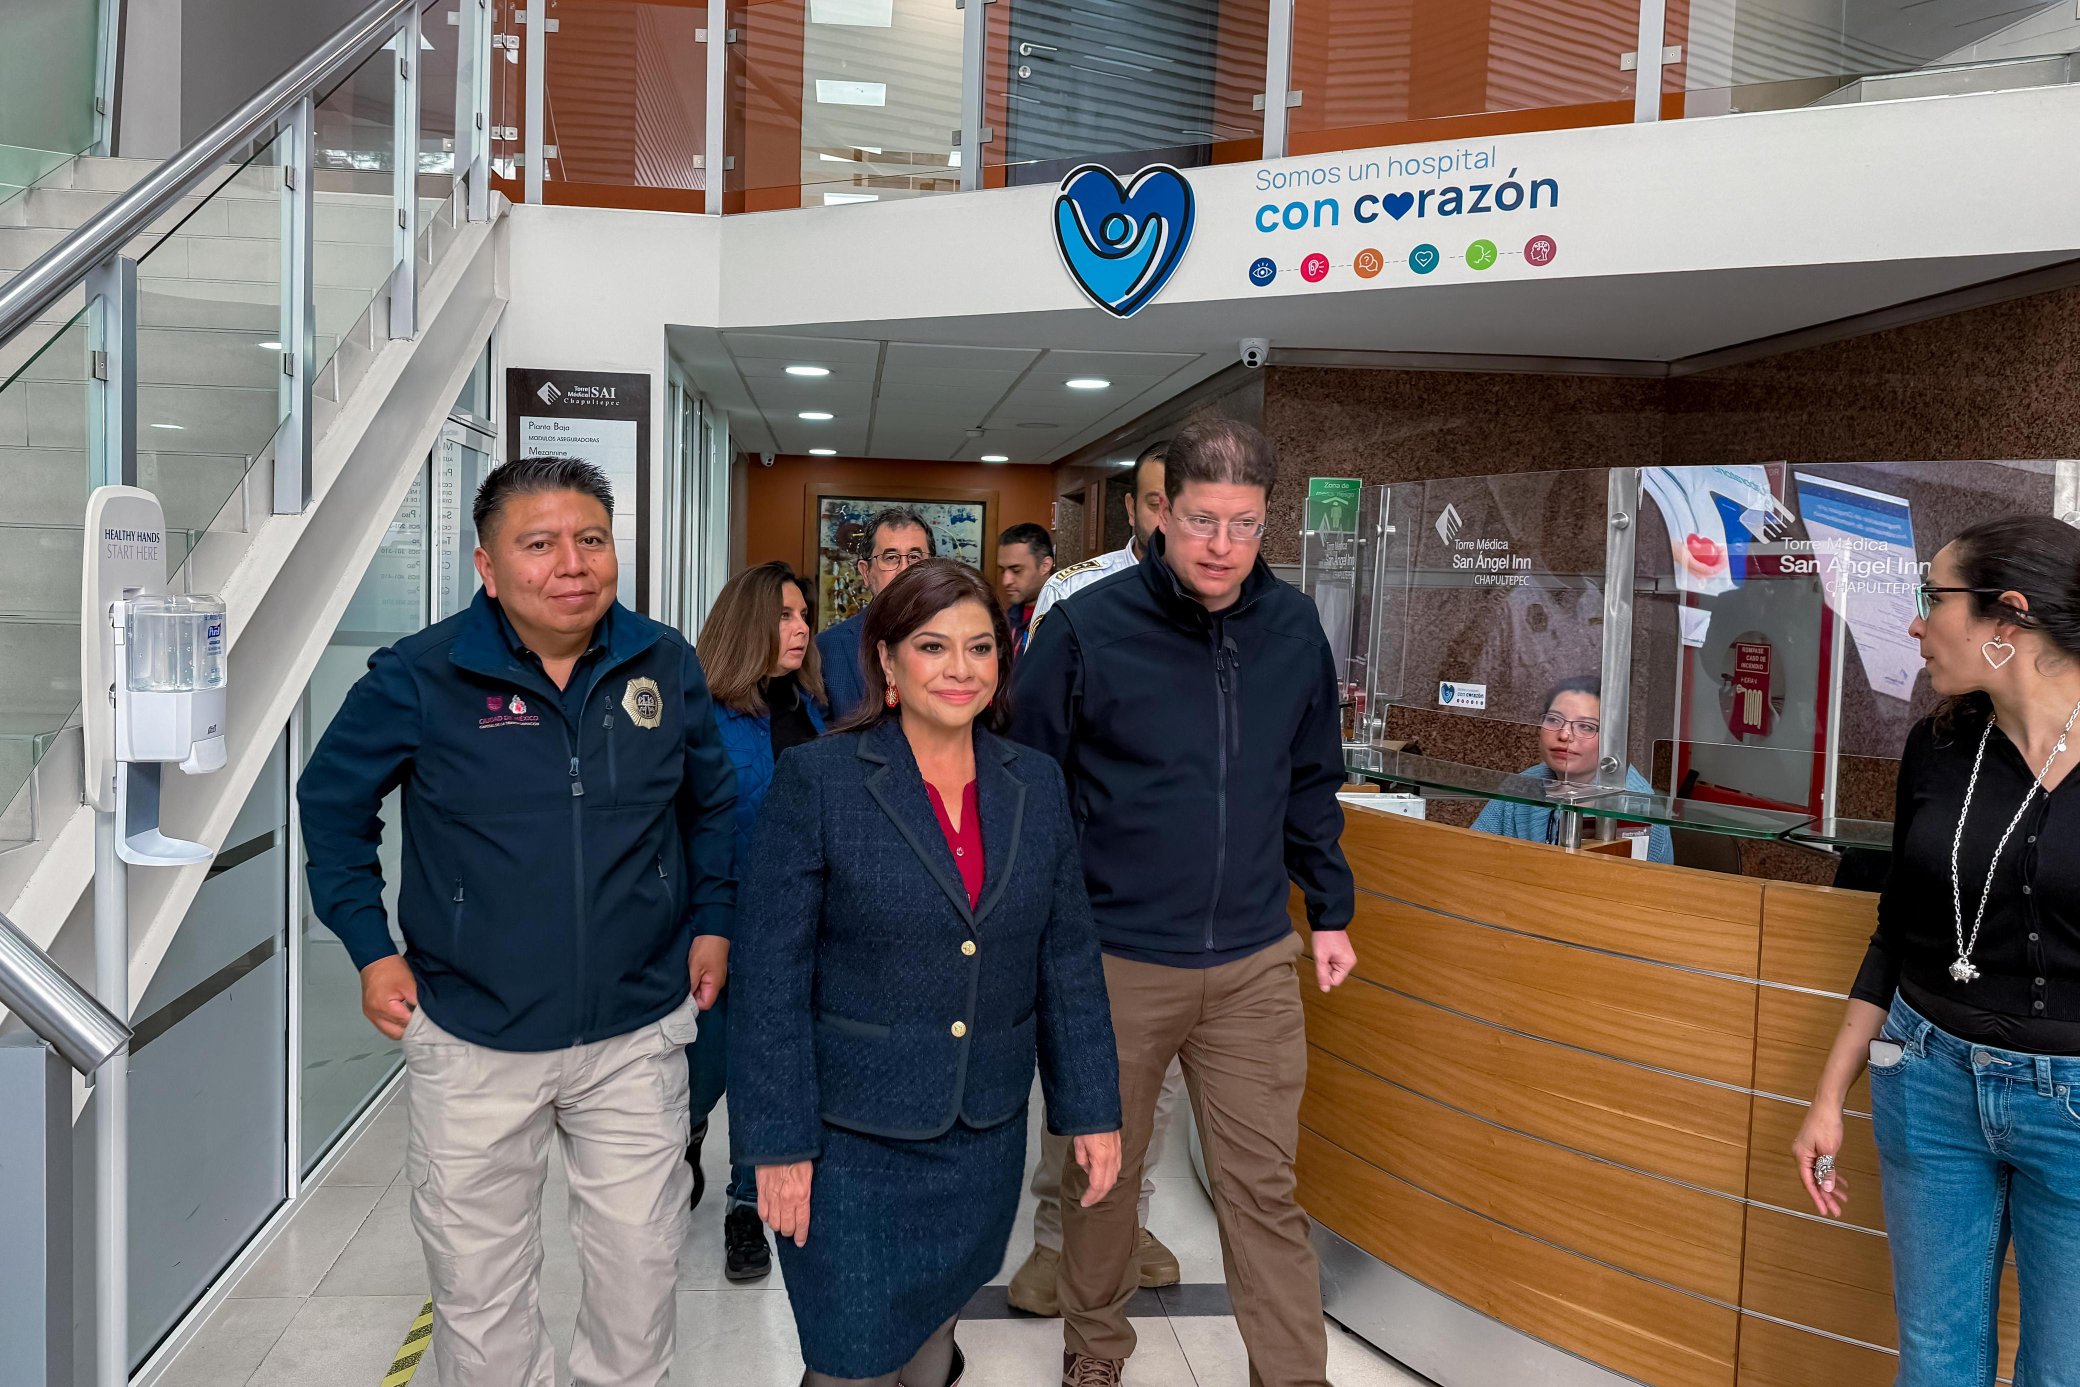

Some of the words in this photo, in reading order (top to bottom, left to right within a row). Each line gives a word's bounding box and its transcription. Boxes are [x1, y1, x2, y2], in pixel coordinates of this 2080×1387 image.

[1256, 166, 1341, 191] Somos
[1348, 160, 1380, 182] un
[1388, 145, 1496, 179] hospital
[1255, 197, 1340, 233] con
[590, 386, 616, 399] SAI
[563, 397, 620, 407] Chapultepec
[528, 421, 551, 431] Planta
[553, 422, 570, 431] Baja
[104, 528, 136, 541] HEALTHY
[137, 531, 160, 543] HANDS
[1454, 538, 1474, 550] Torre
[1476, 538, 1509, 550] Médica
[1781, 537, 1821, 550] Torre
[1827, 537, 1889, 551] Médica
[107, 544, 134, 560] START
[136, 545, 158, 560] HERE
[1452, 554, 1474, 569] San
[1475, 551, 1510, 573] Ángel
[1512, 554, 1532, 570] Inn
[1779, 555, 1821, 573] San
[1826, 552, 1891, 578] Ángel
[1474, 575, 1530, 586] CHAPULTEPEC
